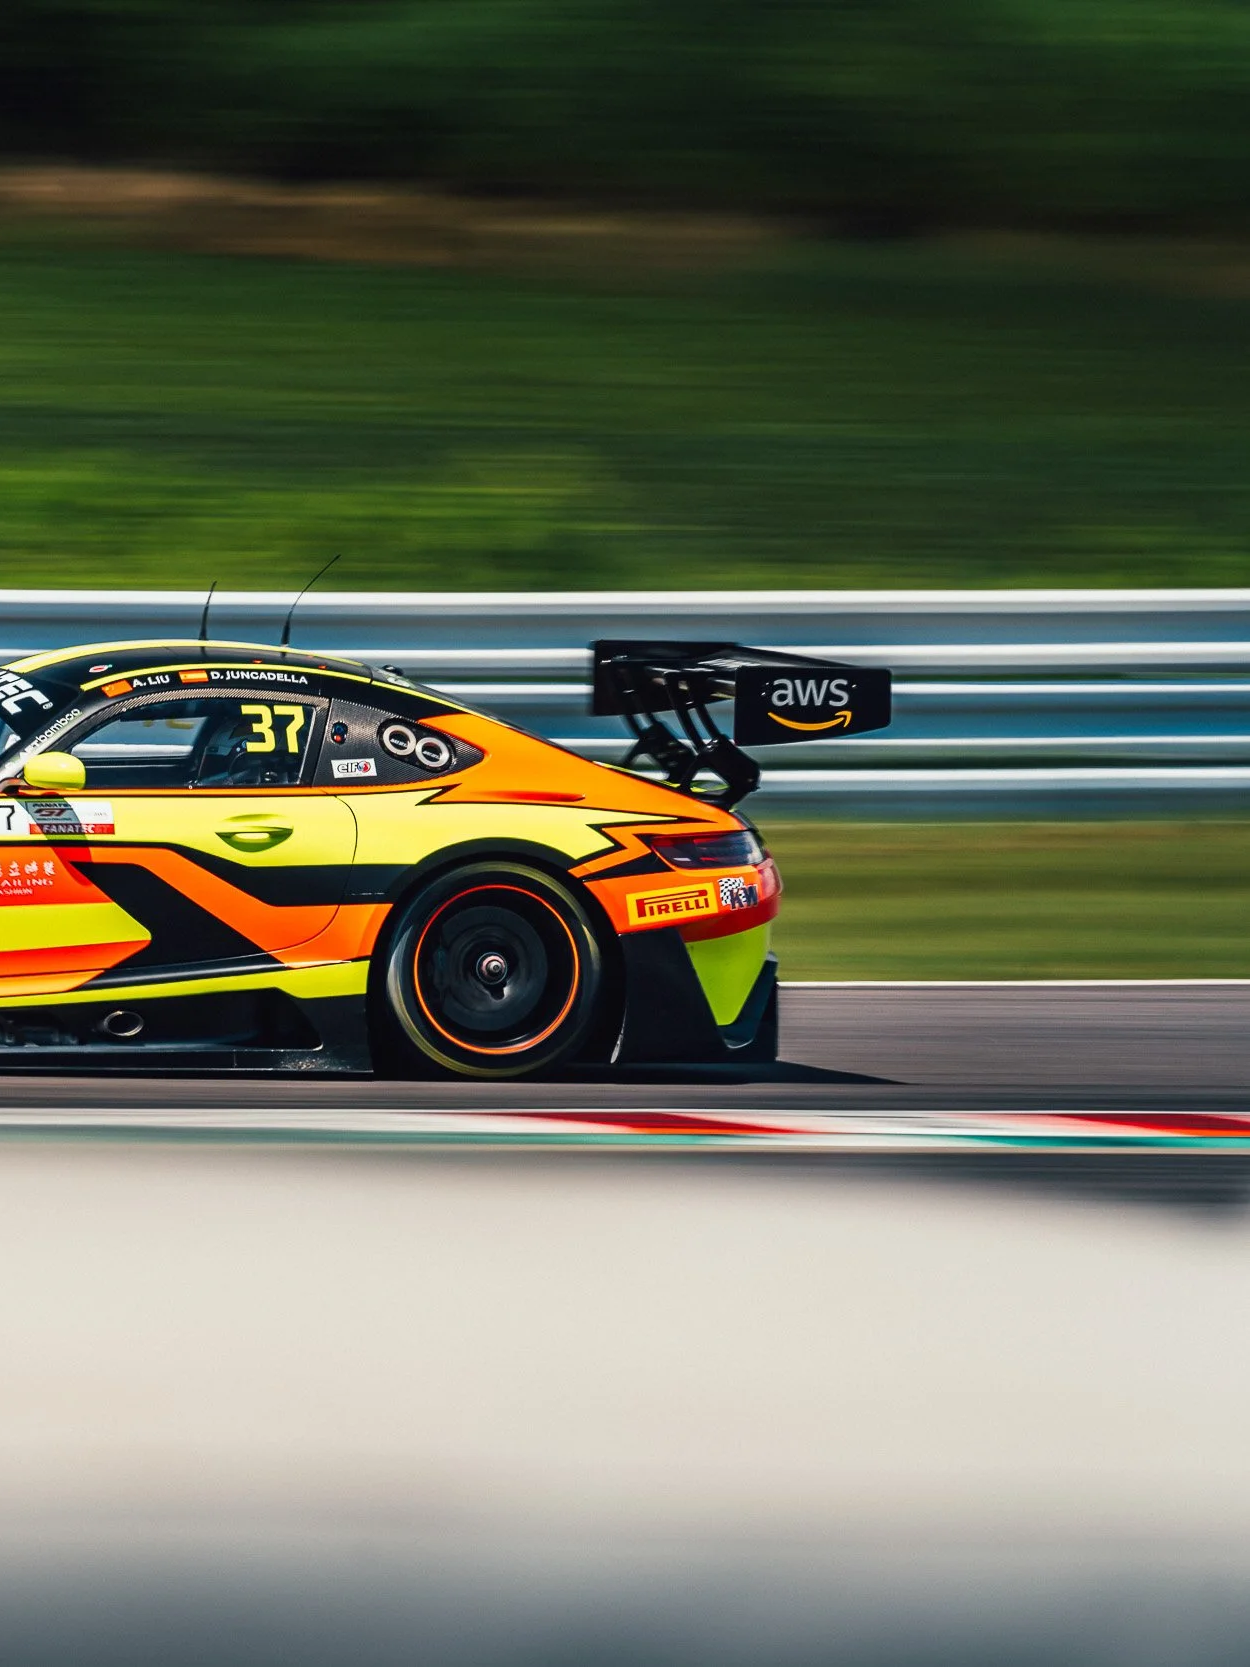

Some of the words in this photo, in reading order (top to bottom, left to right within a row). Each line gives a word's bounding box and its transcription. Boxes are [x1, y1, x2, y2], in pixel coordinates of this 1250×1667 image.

[133, 678, 147, 688] A.
[149, 675, 171, 686] LIU
[210, 671, 224, 680] D.
[225, 670, 308, 685] JUNCADELLA
[771, 678, 849, 707] aws
[240, 704, 305, 754] 37
[336, 761, 360, 774] elf
[43, 824, 96, 834] FANATEC
[636, 889, 710, 918] PIRELLI
